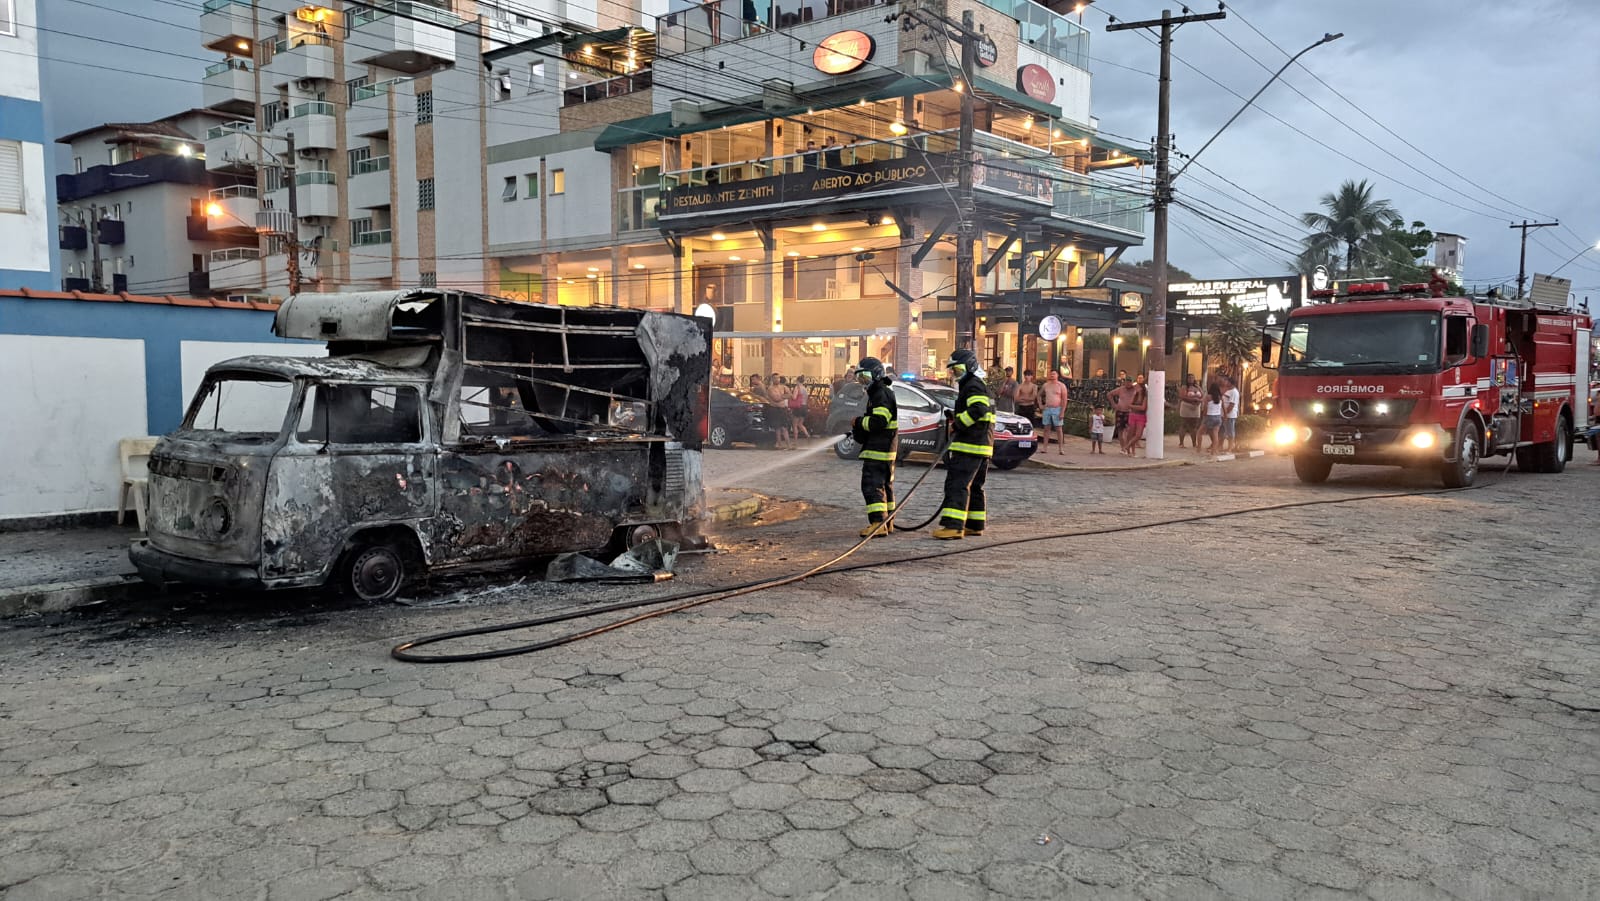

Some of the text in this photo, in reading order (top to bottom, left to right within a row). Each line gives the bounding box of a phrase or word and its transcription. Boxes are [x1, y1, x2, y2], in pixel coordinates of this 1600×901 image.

[673, 165, 926, 207] RESTAURANTE ZENITH ABERTO AO PÚBLICO
[1212, 281, 1229, 290] EM
[1230, 280, 1267, 289] GERAL
[900, 438, 936, 446] MILITAR
